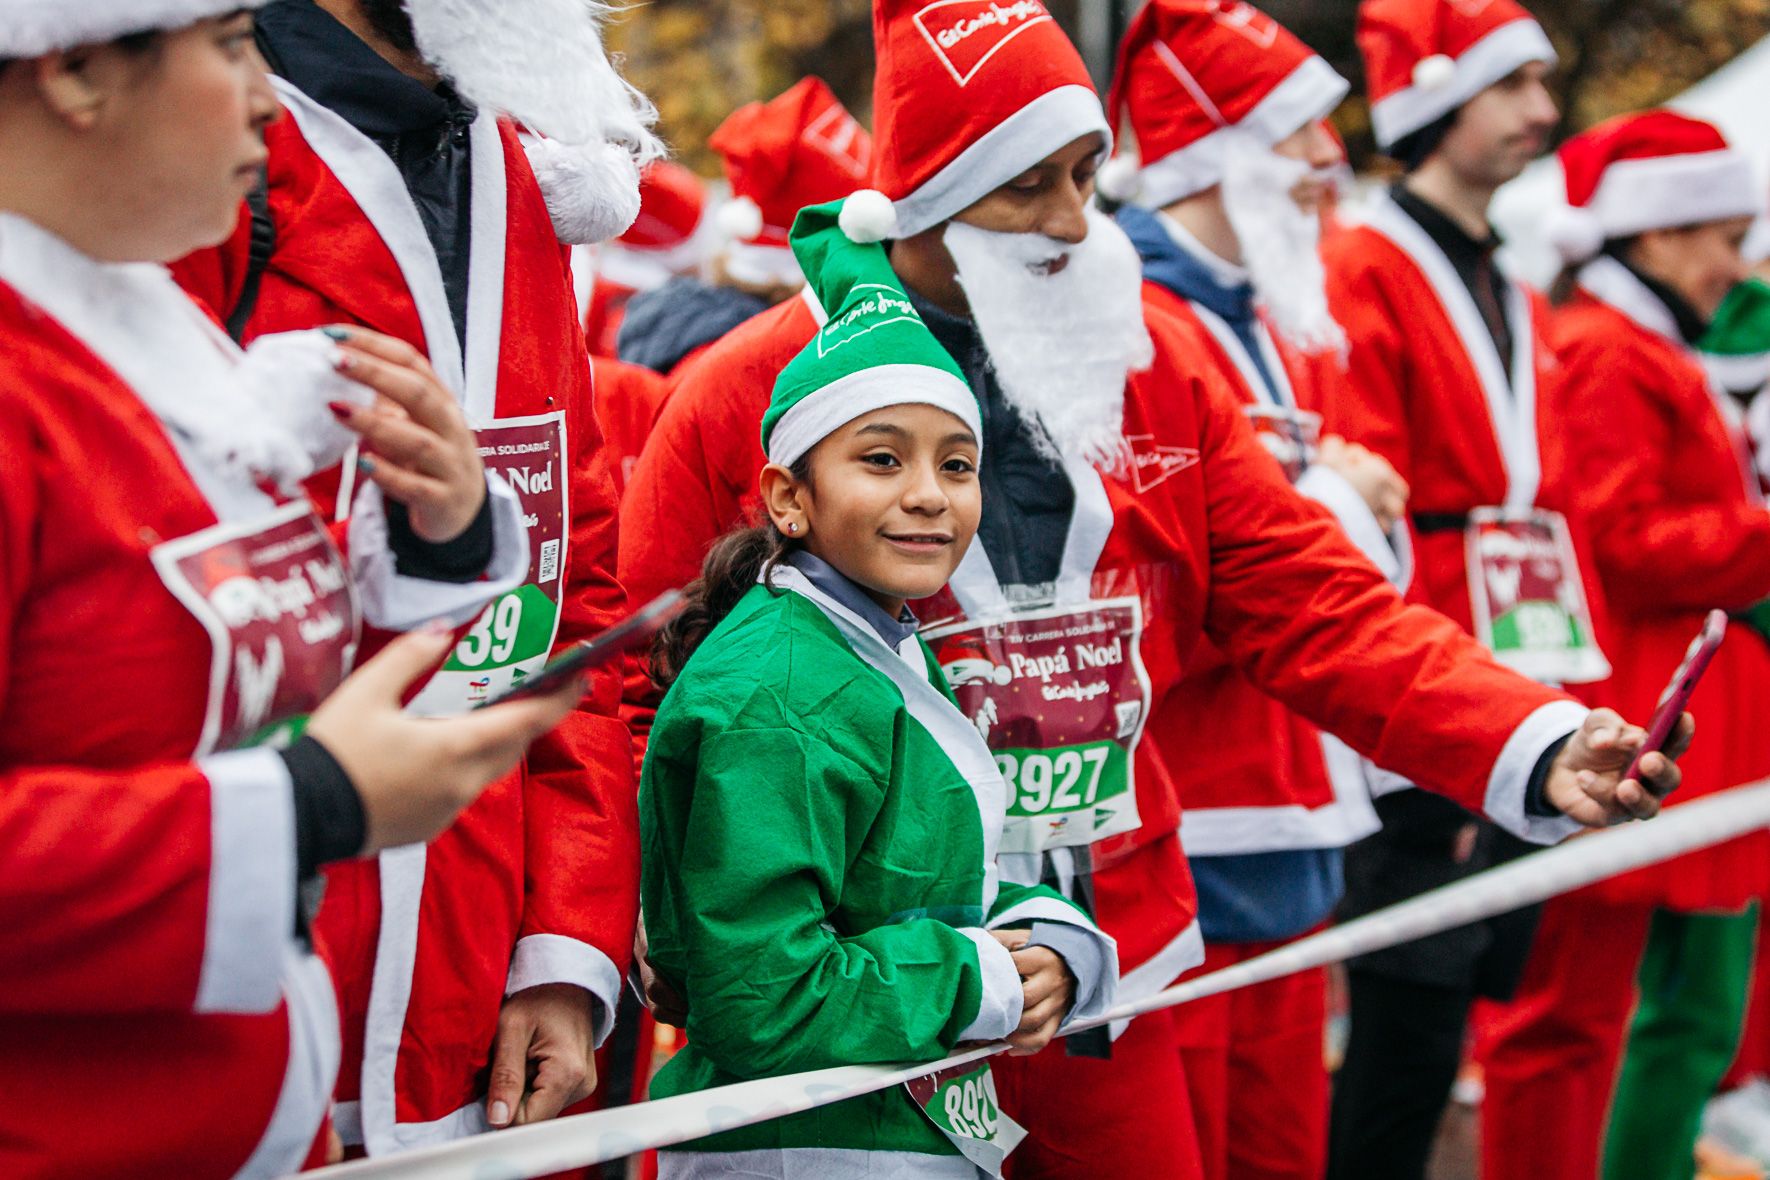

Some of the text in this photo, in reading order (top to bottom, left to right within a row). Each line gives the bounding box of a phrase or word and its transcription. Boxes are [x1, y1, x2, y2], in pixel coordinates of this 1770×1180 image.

[456, 594, 522, 667] 39
[1009, 637, 1123, 683] Papá Noel
[994, 747, 1110, 813] 8927
